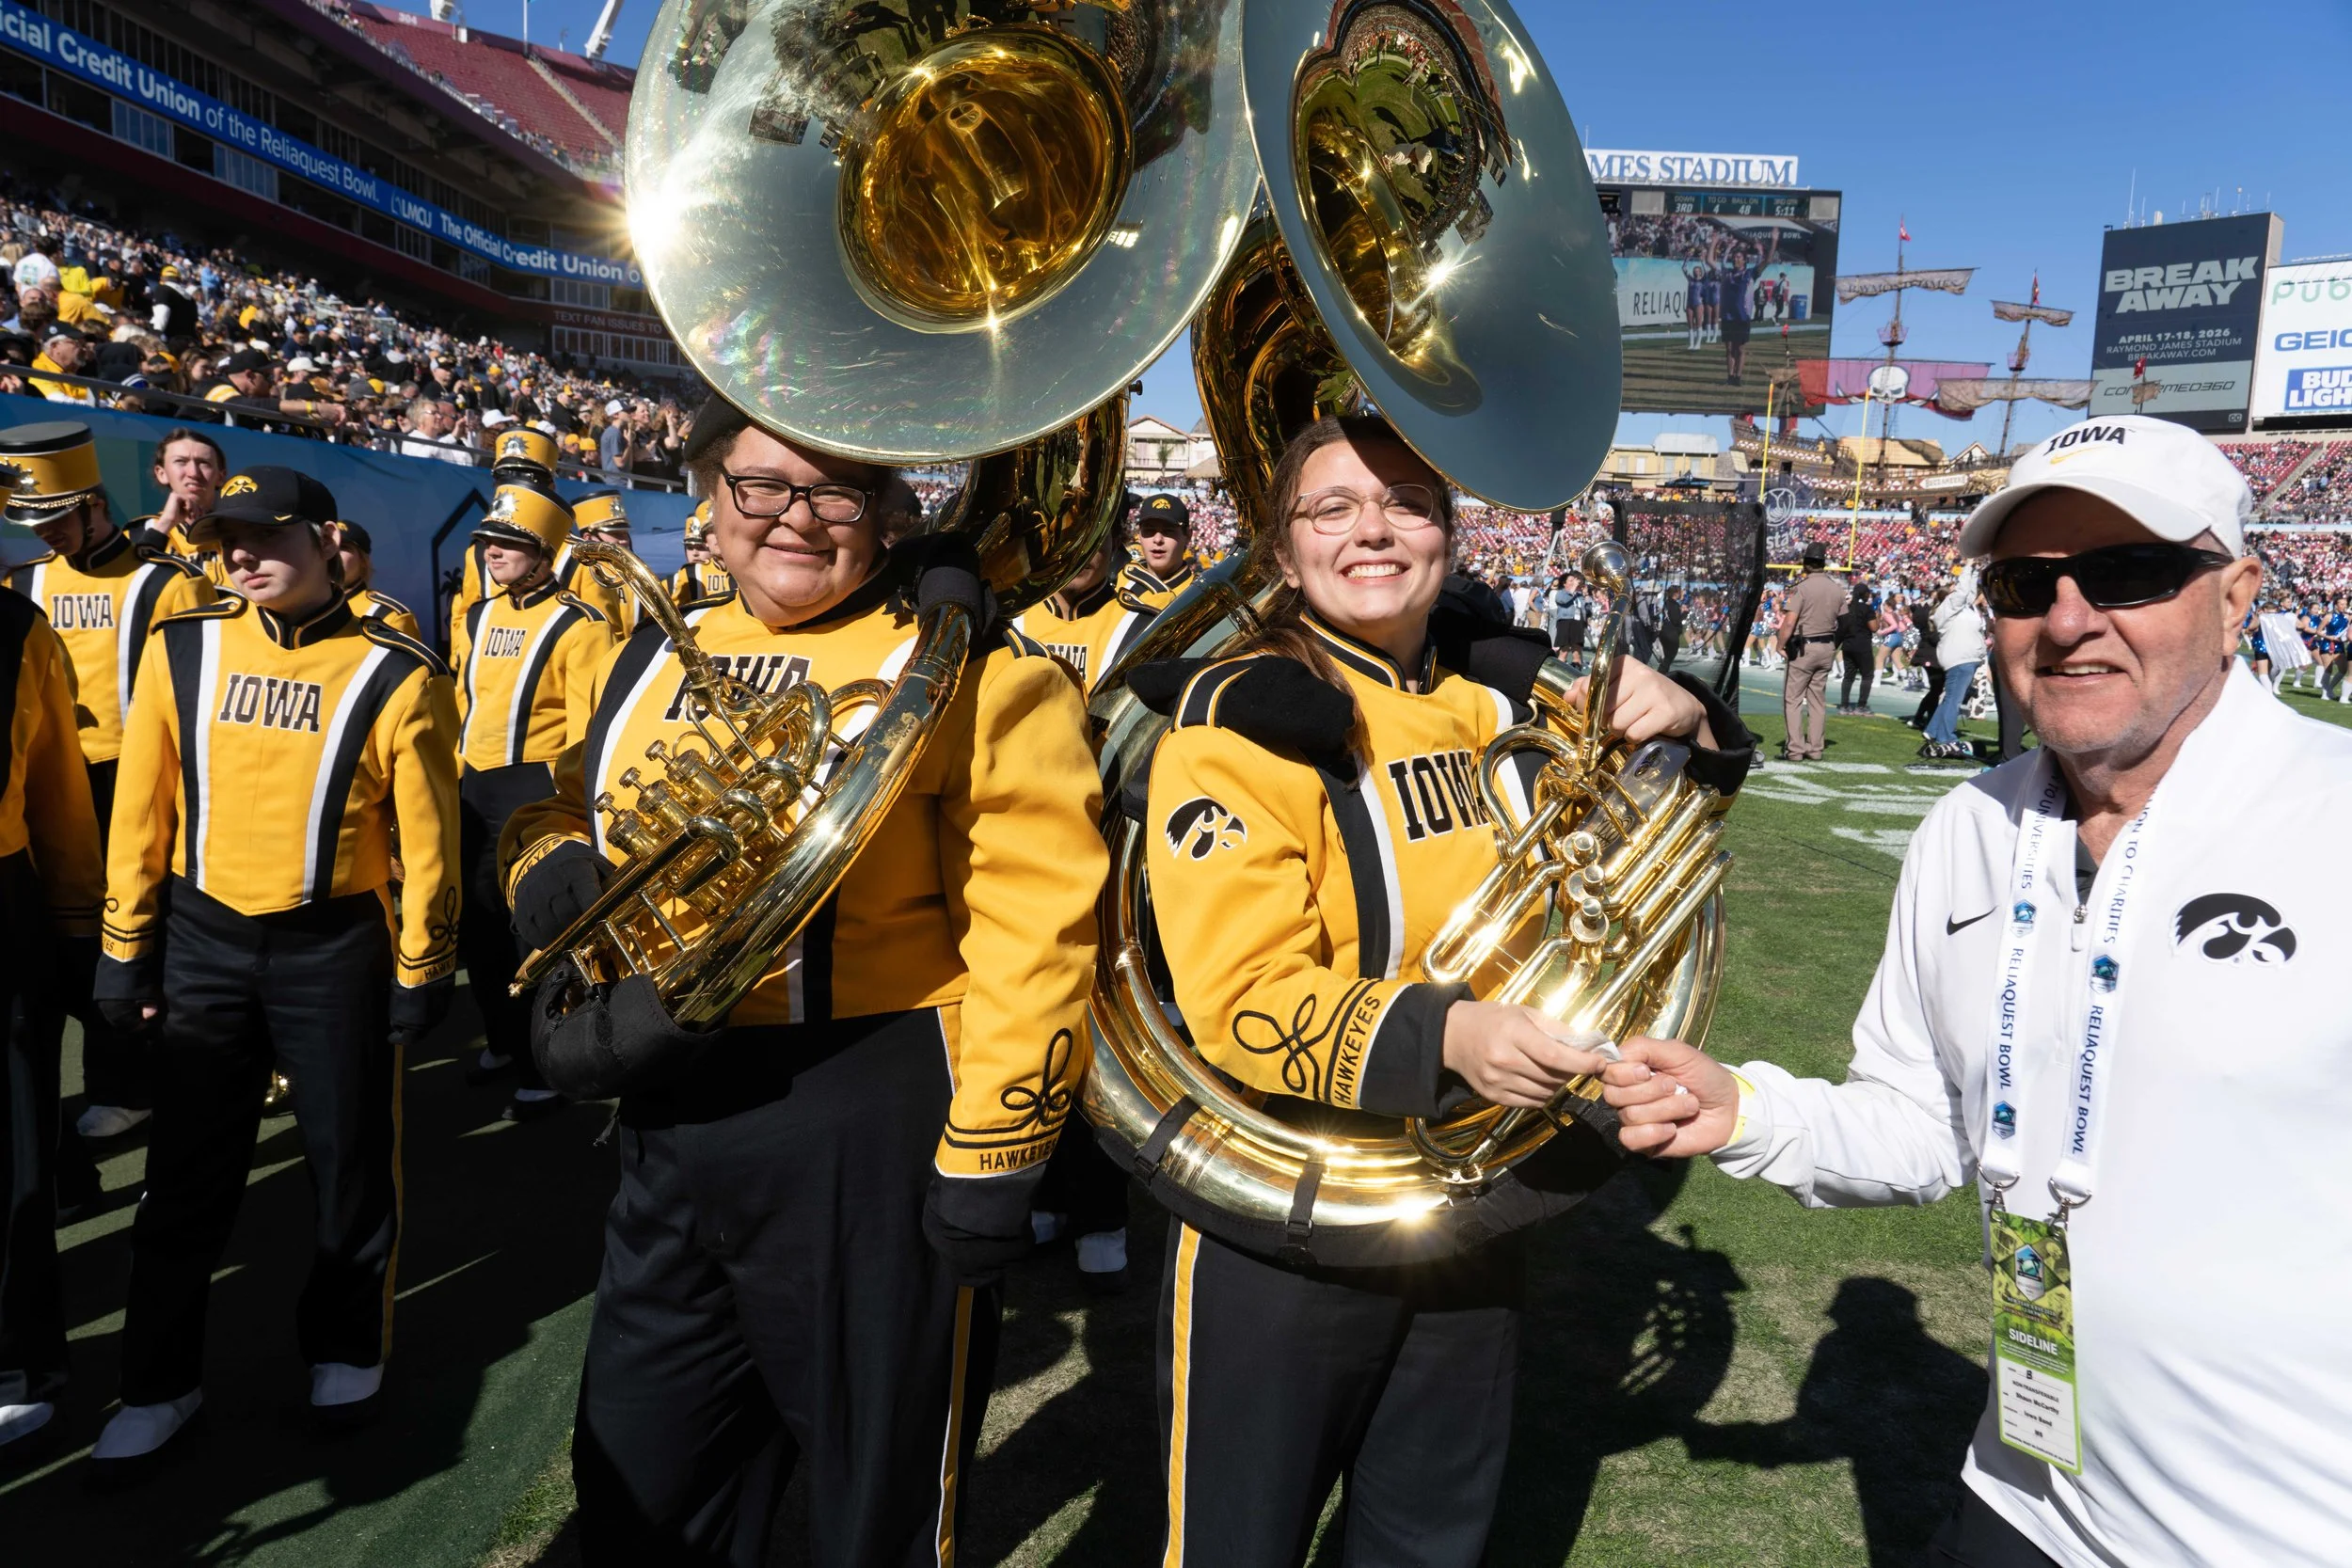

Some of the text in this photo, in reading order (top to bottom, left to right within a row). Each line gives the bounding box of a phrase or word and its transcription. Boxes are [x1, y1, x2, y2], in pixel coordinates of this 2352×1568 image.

[57, 32, 133, 91] Credit
[138, 68, 200, 121] Union
[206, 107, 224, 132] of
[228, 114, 256, 146] the
[261, 127, 341, 185] Reliaquest
[1659, 156, 1793, 185] STADIUM
[1676, 203, 1693, 214] 3RD
[1713, 204, 1720, 214] 4
[401, 198, 432, 229] LMCU
[440, 213, 462, 240] The
[464, 225, 501, 258] Official
[502, 242, 557, 272] Credit
[563, 254, 623, 281] Union
[2105, 256, 2259, 293] BREAK
[2115, 281, 2243, 313] AWAY
[553, 310, 662, 334] TEXT FAN ISSUES TO
[2119, 333, 2153, 344] APRIL
[2198, 327, 2231, 339] 2026
[2106, 337, 2242, 355] RAYMOND JAMES STADIUM
[2127, 348, 2217, 362] BREAKAWAY.COM
[2042, 426, 2126, 456] IOWA
[51, 593, 115, 630] IOWA
[485, 626, 527, 657] IOWA
[218, 673, 323, 734] IOWA
[1386, 749, 1490, 843] IOW
[2124, 840, 2138, 860] TO
[2103, 864, 2134, 944] CHARITIES
[1998, 947, 2024, 1090] RELIAQUEST BOWL
[1334, 995, 1381, 1106] HAWKEYES
[2072, 1005, 2104, 1155] RELIAQUEST BOWL
[2009, 1327, 2058, 1355] SIDELINE
